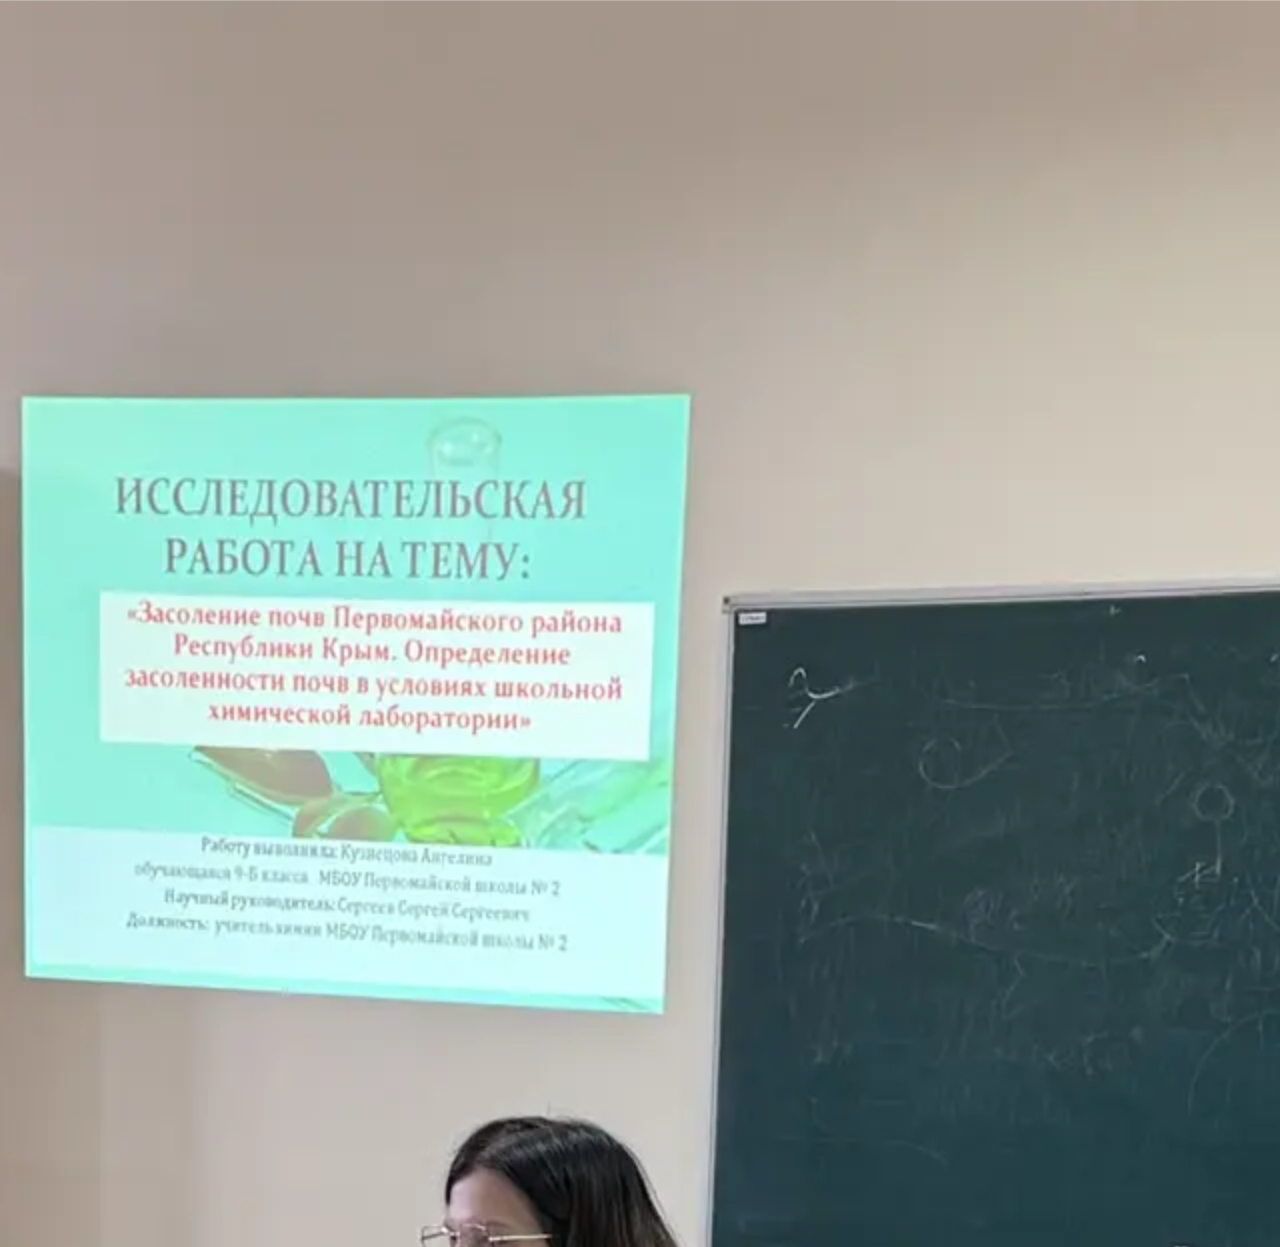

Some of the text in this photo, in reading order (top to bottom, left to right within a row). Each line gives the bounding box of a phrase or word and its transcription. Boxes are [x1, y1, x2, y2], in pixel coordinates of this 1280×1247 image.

[115, 476, 587, 526] ИССЛЕДОВАТЕЛЬСКАЯ
[165, 539, 530, 581] РАБОТА НА ТЕМУ:
[127, 600, 622, 638] «Засоление почв Первомайского района
[174, 633, 571, 669] Республики Крым. Определение
[125, 668, 623, 703] засоленности почв в условиях школьной
[209, 704, 531, 735] химической лаборатории»
[202, 836, 251, 858] Работу
[341, 844, 418, 864] Кузнецова
[262, 869, 308, 884] класса
[319, 870, 362, 887] МБОУ
[364, 872, 471, 893] Первомайской
[475, 880, 527, 895] школы
[531, 880, 548, 895] №
[551, 881, 561, 896] 2
[164, 888, 228, 909] Научный
[398, 900, 449, 920] Сергей
[451, 903, 530, 923] Сергеевич
[126, 911, 209, 930] Должность:
[214, 919, 271, 937] учитель
[326, 922, 369, 941] МБОУ
[372, 925, 478, 948] Первомайской
[482, 934, 533, 950] школы
[538, 934, 555, 951] №
[558, 934, 568, 951] 2
